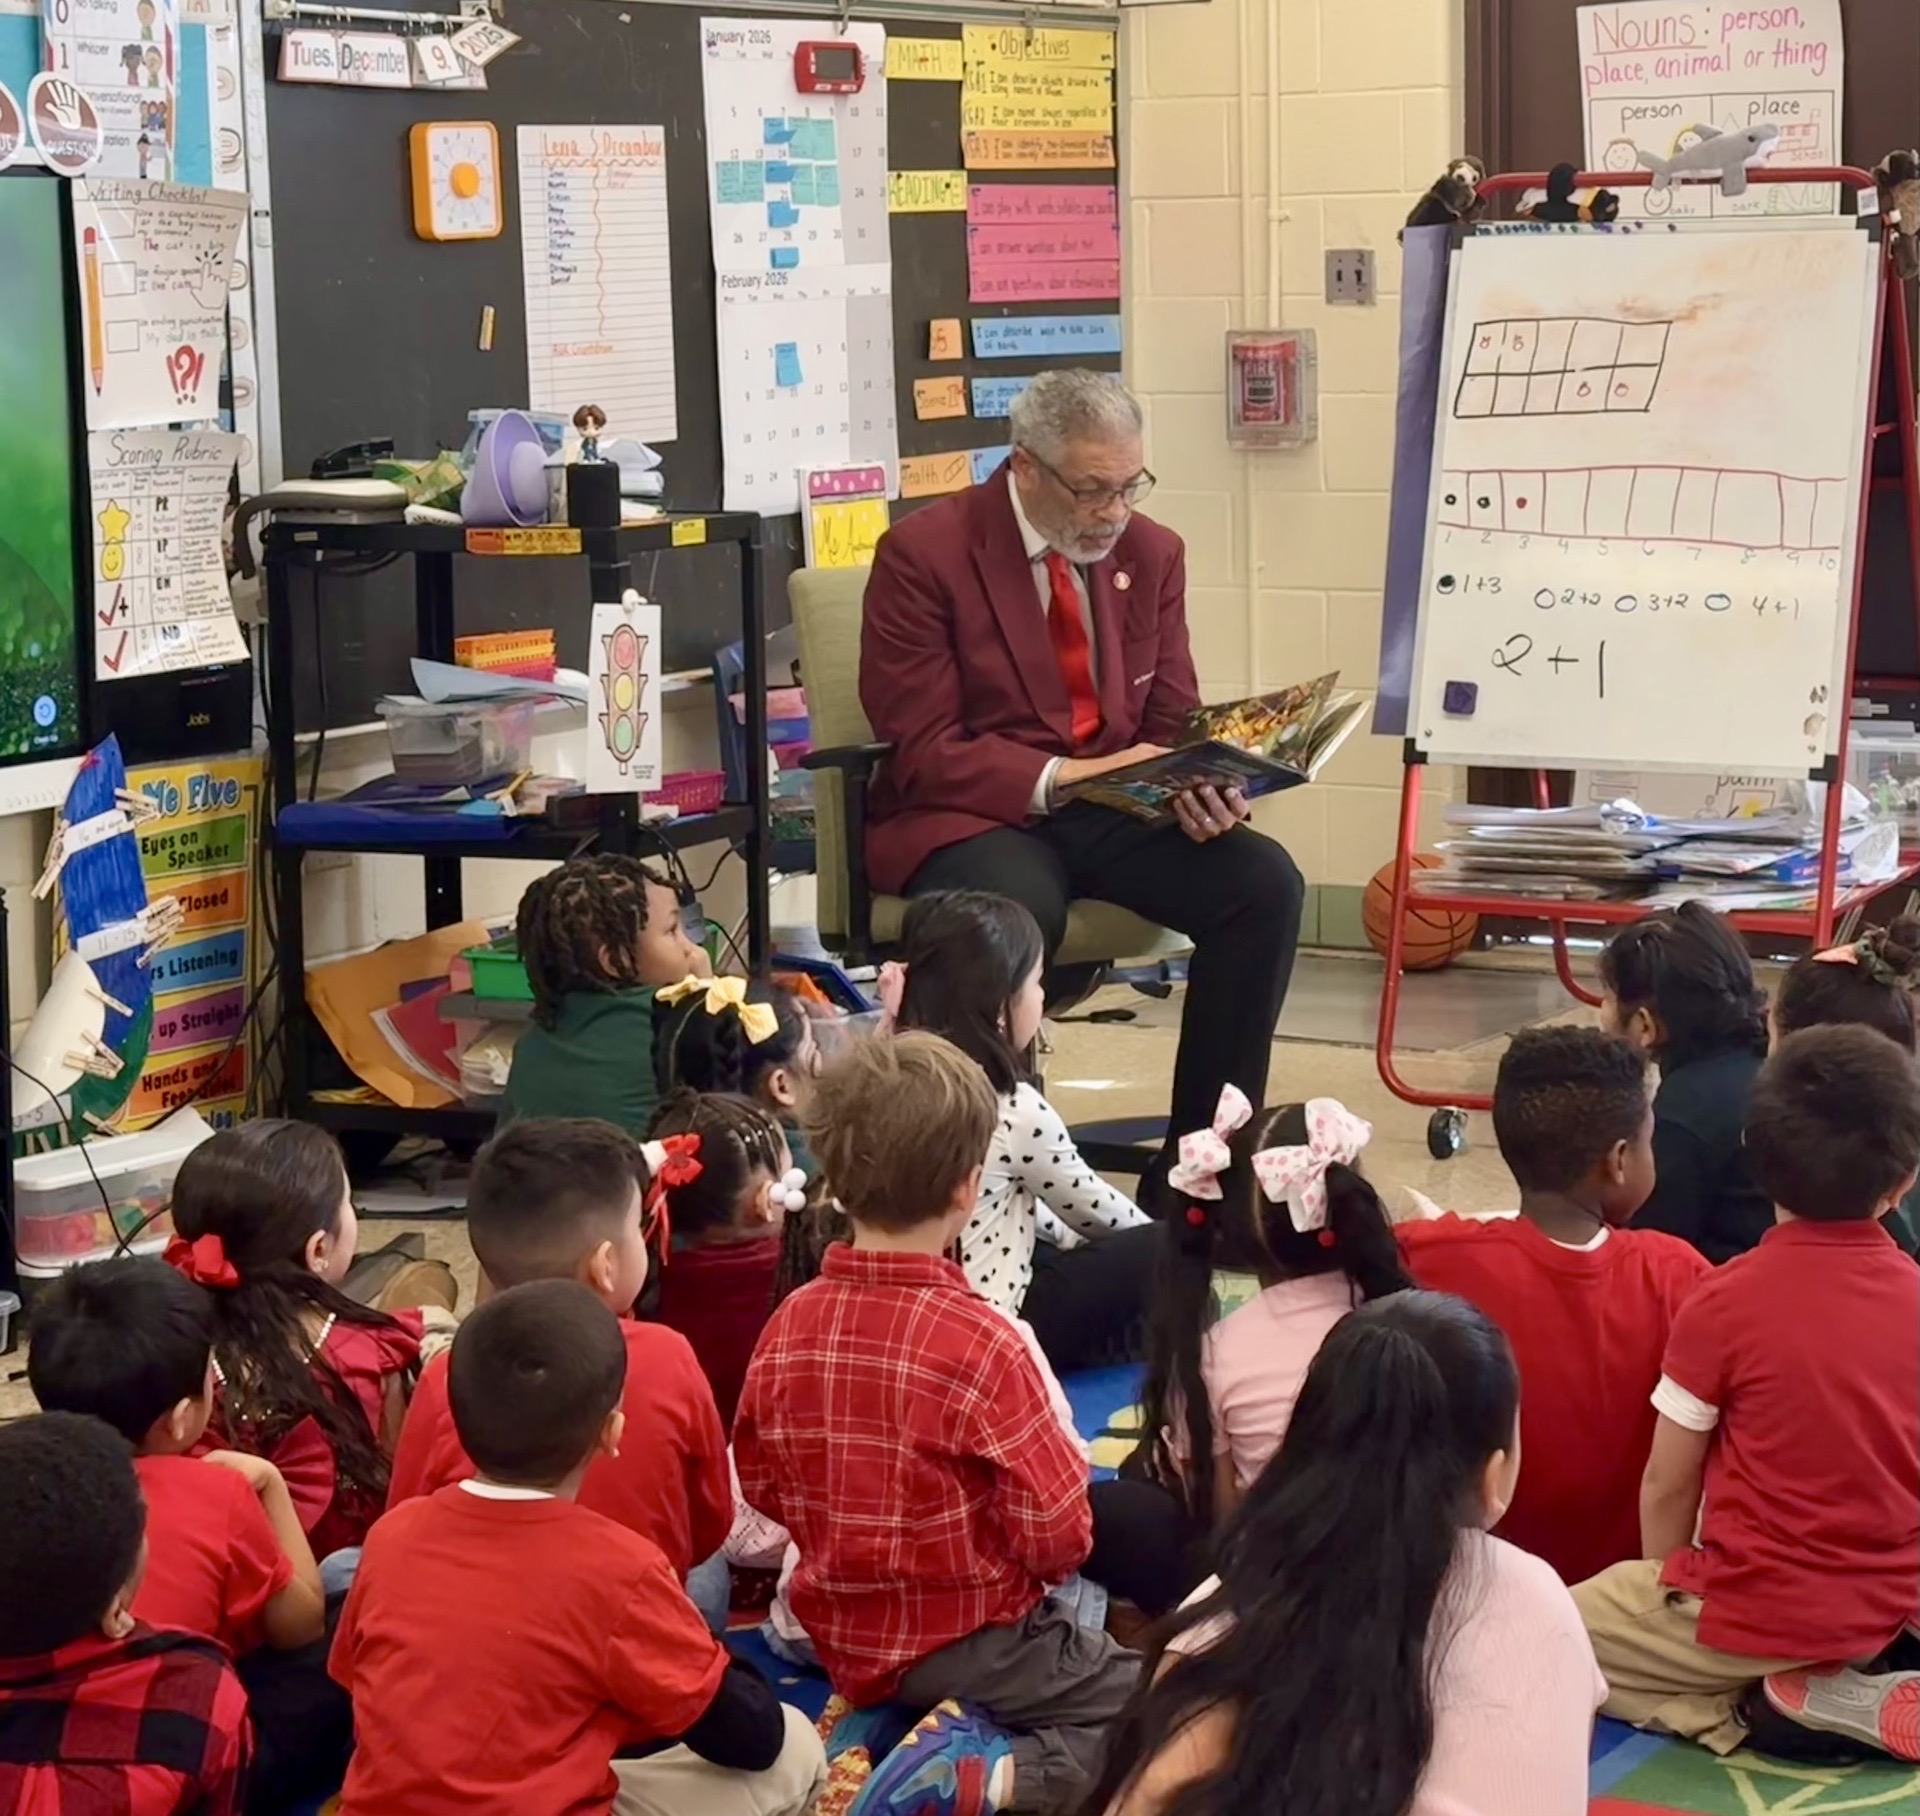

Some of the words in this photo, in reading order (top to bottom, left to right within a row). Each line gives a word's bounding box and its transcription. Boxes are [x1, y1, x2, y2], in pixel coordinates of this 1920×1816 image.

[55, 0, 69, 24] 0
[1719, 6, 1806, 44] person,
[290, 40, 336, 69] Tues.
[340, 43, 406, 74] December
[459, 25, 506, 58] 2025
[705, 28, 746, 46] January
[747, 29, 772, 45] 2026
[999, 28, 1070, 61] Objectives
[60, 42, 69, 70] 1
[76, 41, 110, 56] Whisper
[899, 41, 942, 74] MATH
[1584, 55, 1650, 98] place,
[1654, 41, 1731, 79] animal
[1743, 48, 1764, 68] or
[1772, 37, 1828, 77] thing
[86, 90, 142, 105] onversational
[1620, 102, 1683, 134] person
[1747, 93, 1801, 127] place
[87, 179, 143, 205] Writing
[148, 180, 208, 204] Checklist
[143, 236, 160, 252] The
[165, 241, 184, 251] cat
[733, 232, 744, 244] 26
[138, 281, 147, 293] I
[150, 280, 166, 291] like
[721, 273, 762, 292] February
[764, 271, 789, 287] 2026
[106, 433, 163, 469] Scoring
[171, 435, 223, 463] Rubric
[901, 462, 939, 485] Health
[1444, 531, 1453, 544] 1
[1480, 529, 1492, 545] 2
[1518, 534, 1530, 550] 3
[1557, 538, 1570, 555] 4
[1597, 539, 1609, 556] 5
[1642, 539, 1656, 557] 6
[1687, 546, 1702, 562] 7
[1740, 548, 1756, 565] 8
[1786, 550, 1801, 566] 9
[1818, 546, 1837, 571] 10
[186, 712, 211, 727] Jobs
[186, 771, 240, 812] Five
[141, 834, 176, 857] Eyes
[180, 831, 199, 846] on
[168, 843, 230, 869] Speaker
[150, 965, 165, 980] rs
[169, 948, 239, 978] Listening
[158, 1016, 178, 1041] up
[181, 1003, 241, 1034] Straight
[141, 1066, 188, 1092] Hands
[192, 1057, 219, 1079] and
